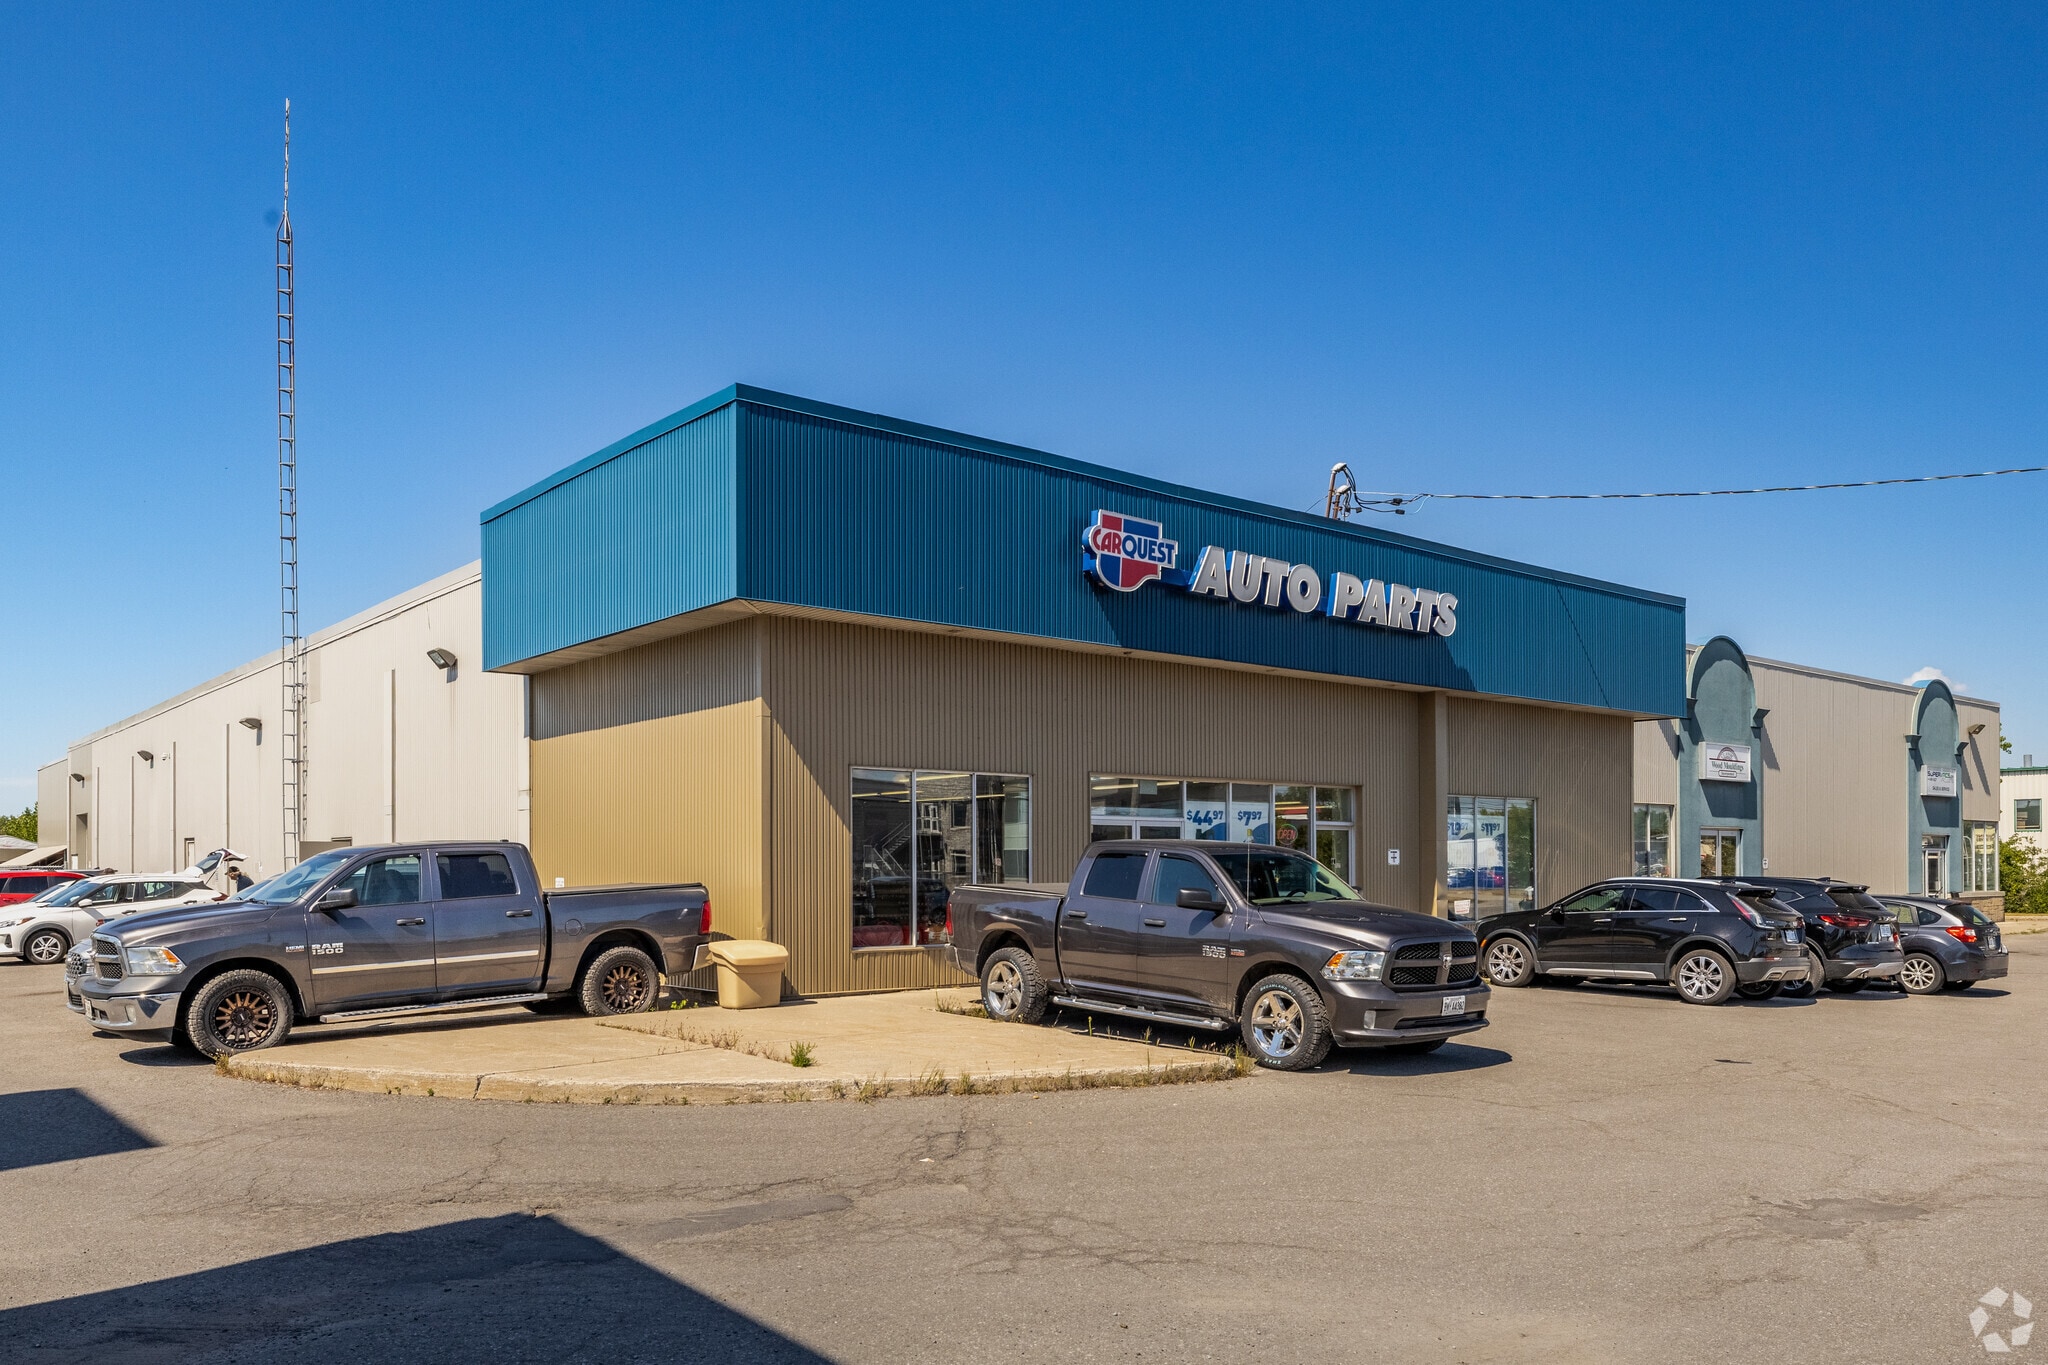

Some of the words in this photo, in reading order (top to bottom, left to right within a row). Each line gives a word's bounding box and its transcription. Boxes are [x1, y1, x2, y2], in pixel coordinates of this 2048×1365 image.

[1092, 528, 1175, 565] CARQUEST
[1189, 545, 1321, 613] AUTO
[1330, 571, 1459, 637] PARTS
[1277, 828, 1296, 840] OPEN
